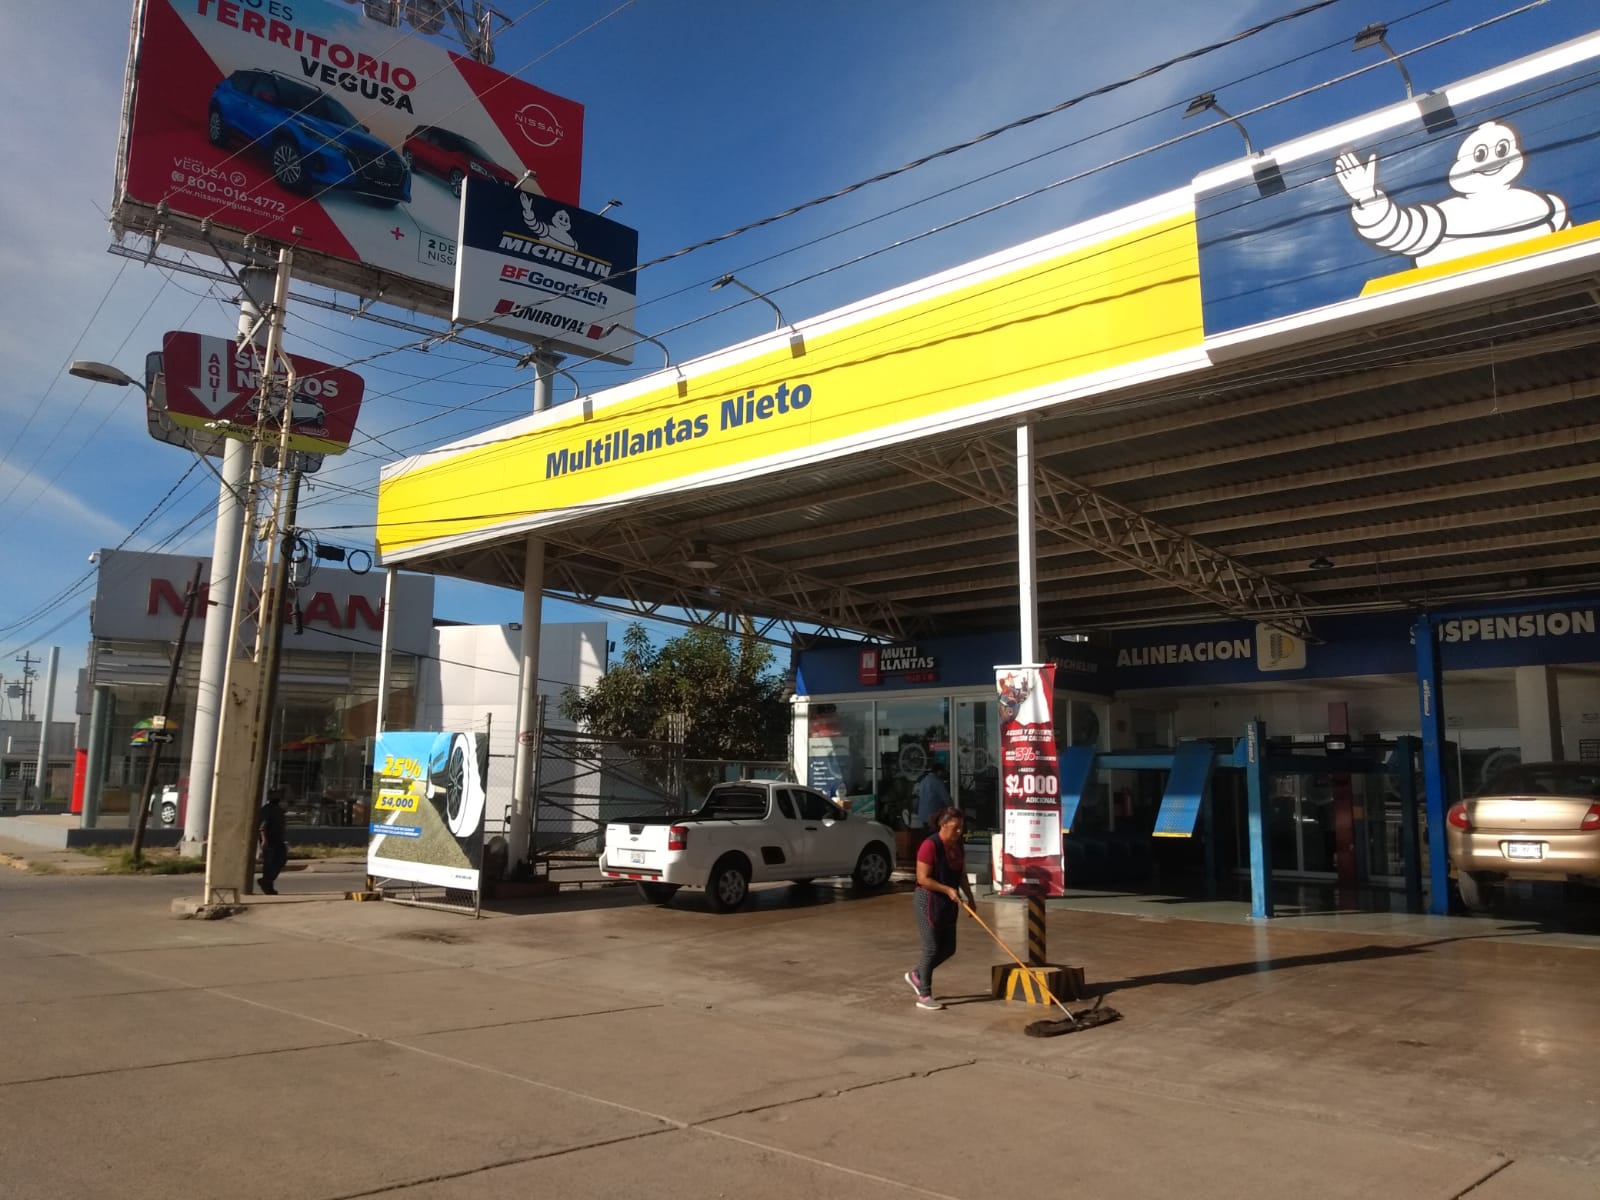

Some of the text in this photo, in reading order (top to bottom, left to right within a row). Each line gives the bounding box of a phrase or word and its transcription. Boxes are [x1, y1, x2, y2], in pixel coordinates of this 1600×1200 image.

[197, 0, 417, 92] TERRITORIO
[300, 56, 414, 115] VEGUSA
[514, 112, 565, 137] NISSAN
[173, 157, 228, 182] VEGUSA
[188, 175, 286, 213] 800-016-4772
[428, 239, 436, 249] 2
[428, 250, 457, 267] NISS
[499, 236, 612, 278] MICHELIN
[500, 264, 608, 306] BFGoodrich
[511, 303, 585, 335] UNIROYAL
[208, 353, 221, 402] AQUÍ
[545, 381, 812, 480] Multillantas Nieto
[880, 656, 935, 671] LLANTAS
[881, 646, 917, 659] MULTI
[1115, 639, 1252, 667] ALINEACION
[1025, 797, 1057, 805] ADICIONAL
